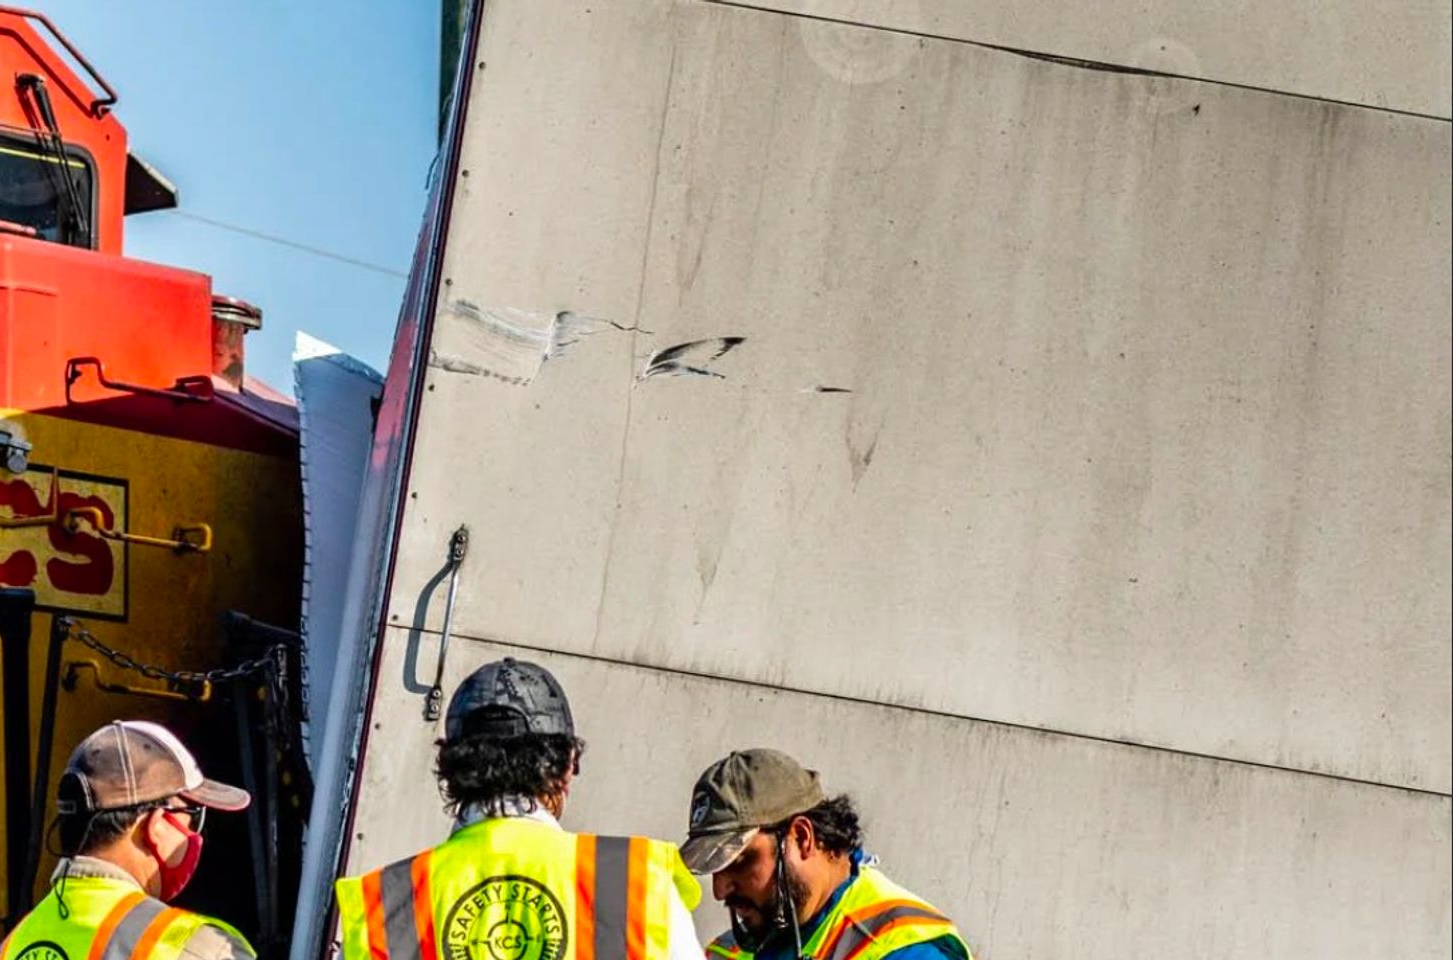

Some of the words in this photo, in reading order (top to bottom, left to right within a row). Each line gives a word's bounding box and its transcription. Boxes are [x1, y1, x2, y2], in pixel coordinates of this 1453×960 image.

[451, 885, 503, 941] SAFETY
[511, 884, 561, 934] STARTS
[494, 935, 522, 950] KCS
